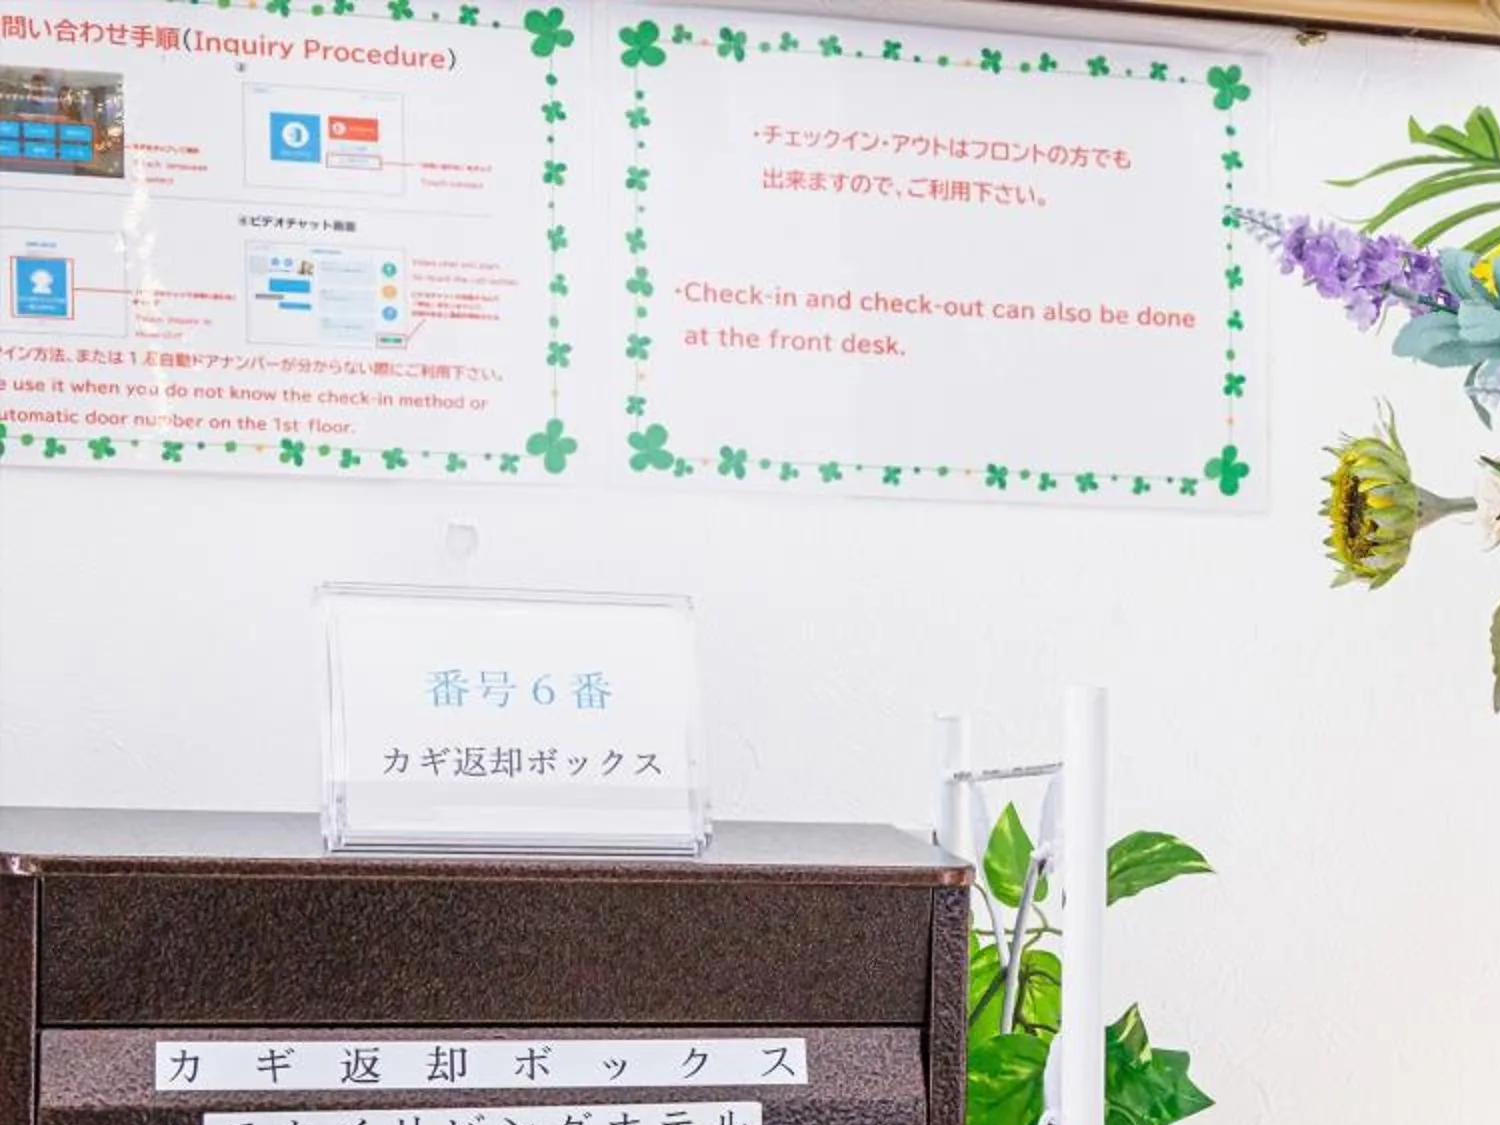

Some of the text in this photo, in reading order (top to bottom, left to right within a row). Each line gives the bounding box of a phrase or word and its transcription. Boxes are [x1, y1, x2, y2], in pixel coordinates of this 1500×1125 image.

[303, 39, 457, 71] Procedure)
[762, 168, 1047, 206] 出来ますので、ご利用下さい。
[806, 291, 850, 310] and
[860, 293, 983, 317] check-out
[992, 302, 1034, 319] can
[1043, 302, 1092, 323] also
[1100, 304, 1128, 325] be
[1137, 306, 1195, 328] done
[684, 328, 905, 355] at the front desk.
[13, 379, 45, 392] use
[52, 379, 64, 393] it
[71, 380, 120, 394] when
[165, 384, 188, 398] do
[194, 386, 223, 399] not
[229, 386, 277, 401] know
[283, 388, 311, 404] the
[317, 390, 393, 406] check-in
[399, 394, 464, 409] method
[469, 398, 486, 410] or
[85, 410, 127, 425] door
[133, 411, 201, 428] nuber
[209, 415, 231, 429] on
[238, 414, 267, 431] the
[383, 746, 663, 777] カギ返却ボックス
